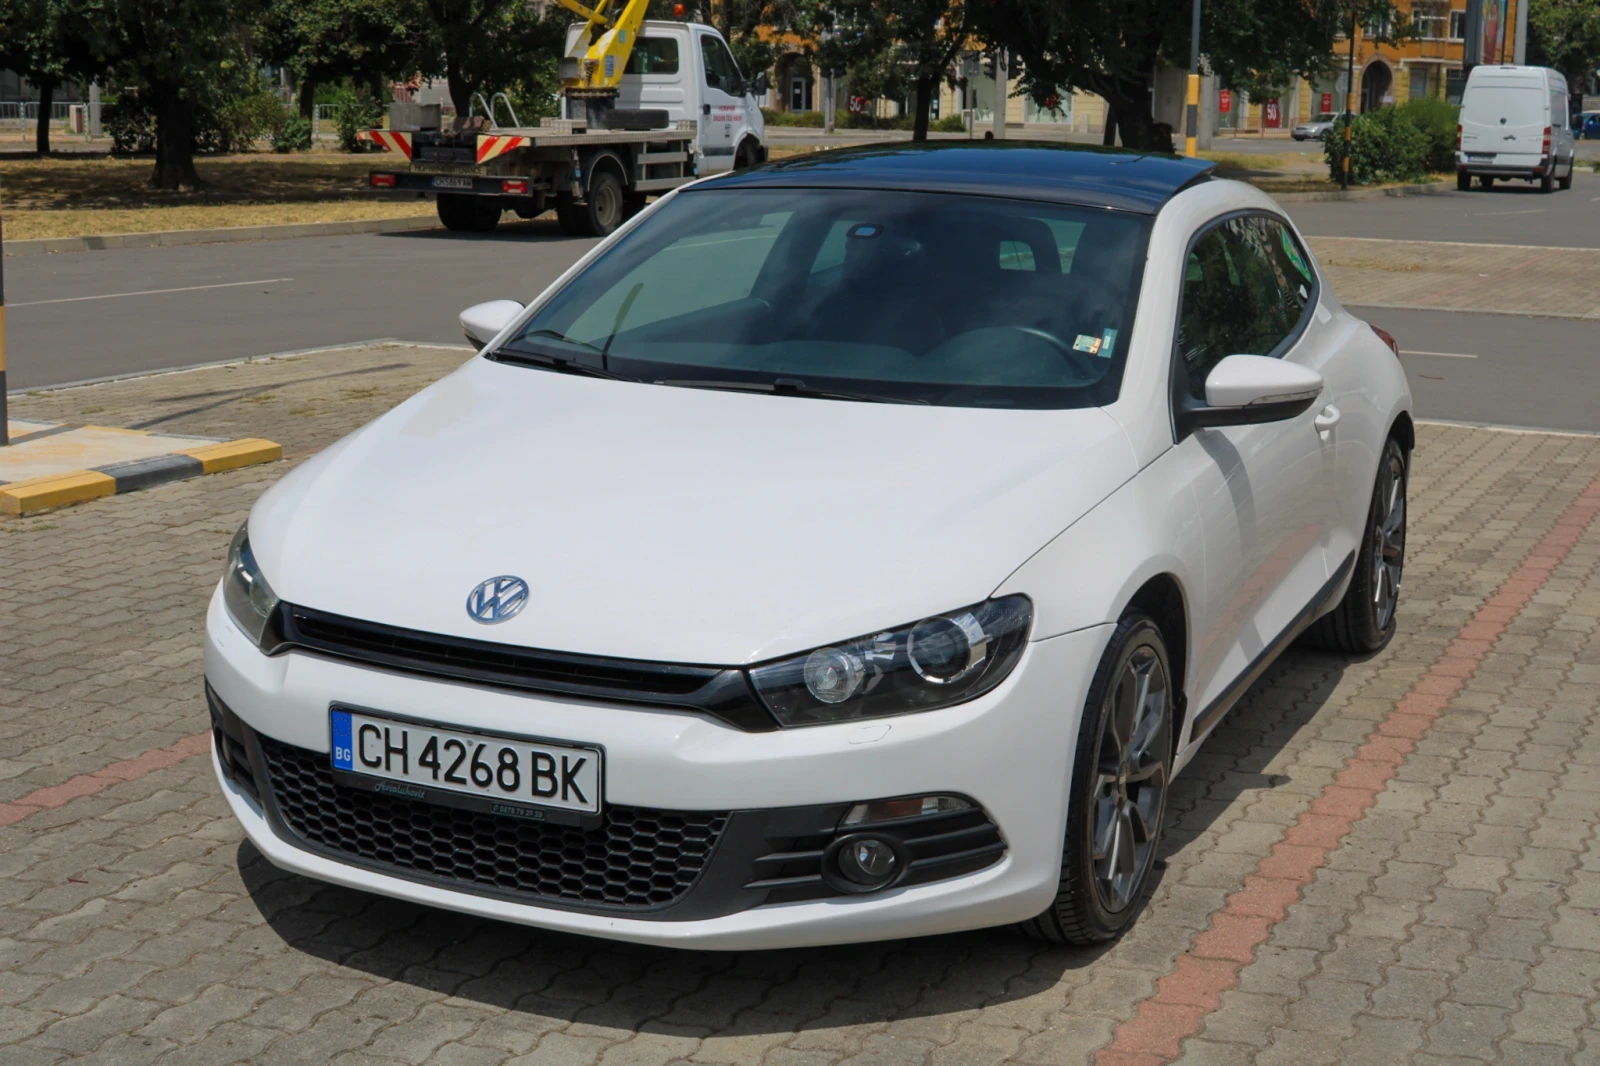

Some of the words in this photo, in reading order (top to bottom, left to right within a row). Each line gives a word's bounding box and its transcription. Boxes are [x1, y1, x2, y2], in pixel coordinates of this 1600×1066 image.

[466, 575, 529, 625] VW
[335, 746, 351, 761] BG
[358, 723, 409, 775] CH
[418, 735, 520, 793] 4268
[531, 750, 589, 804] BK
